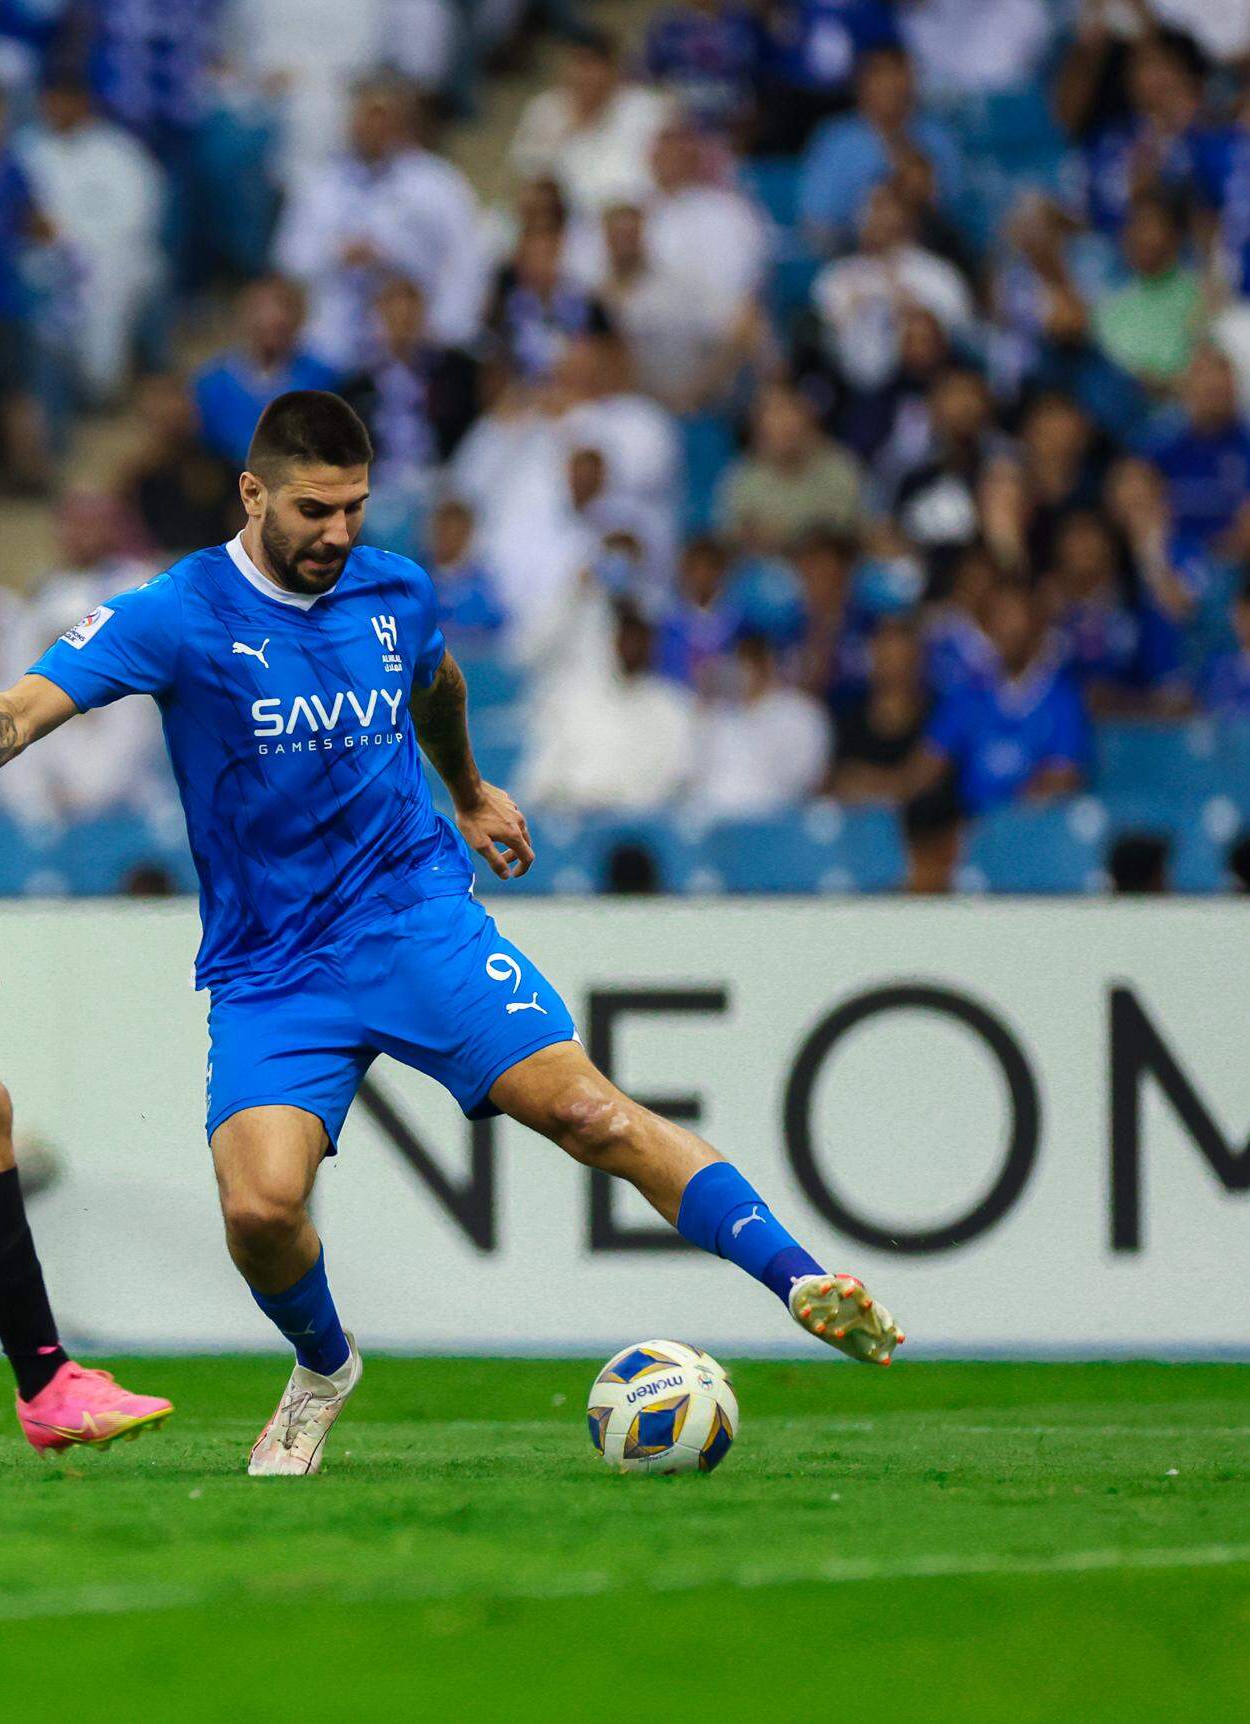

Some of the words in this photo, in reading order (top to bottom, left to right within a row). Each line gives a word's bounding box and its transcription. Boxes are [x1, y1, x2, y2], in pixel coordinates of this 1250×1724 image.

[251, 688, 403, 737] SAVVY
[258, 738, 333, 755] GAMES
[344, 732, 403, 748] GROUP
[485, 952, 522, 994] 9
[625, 1375, 684, 1404] molten
